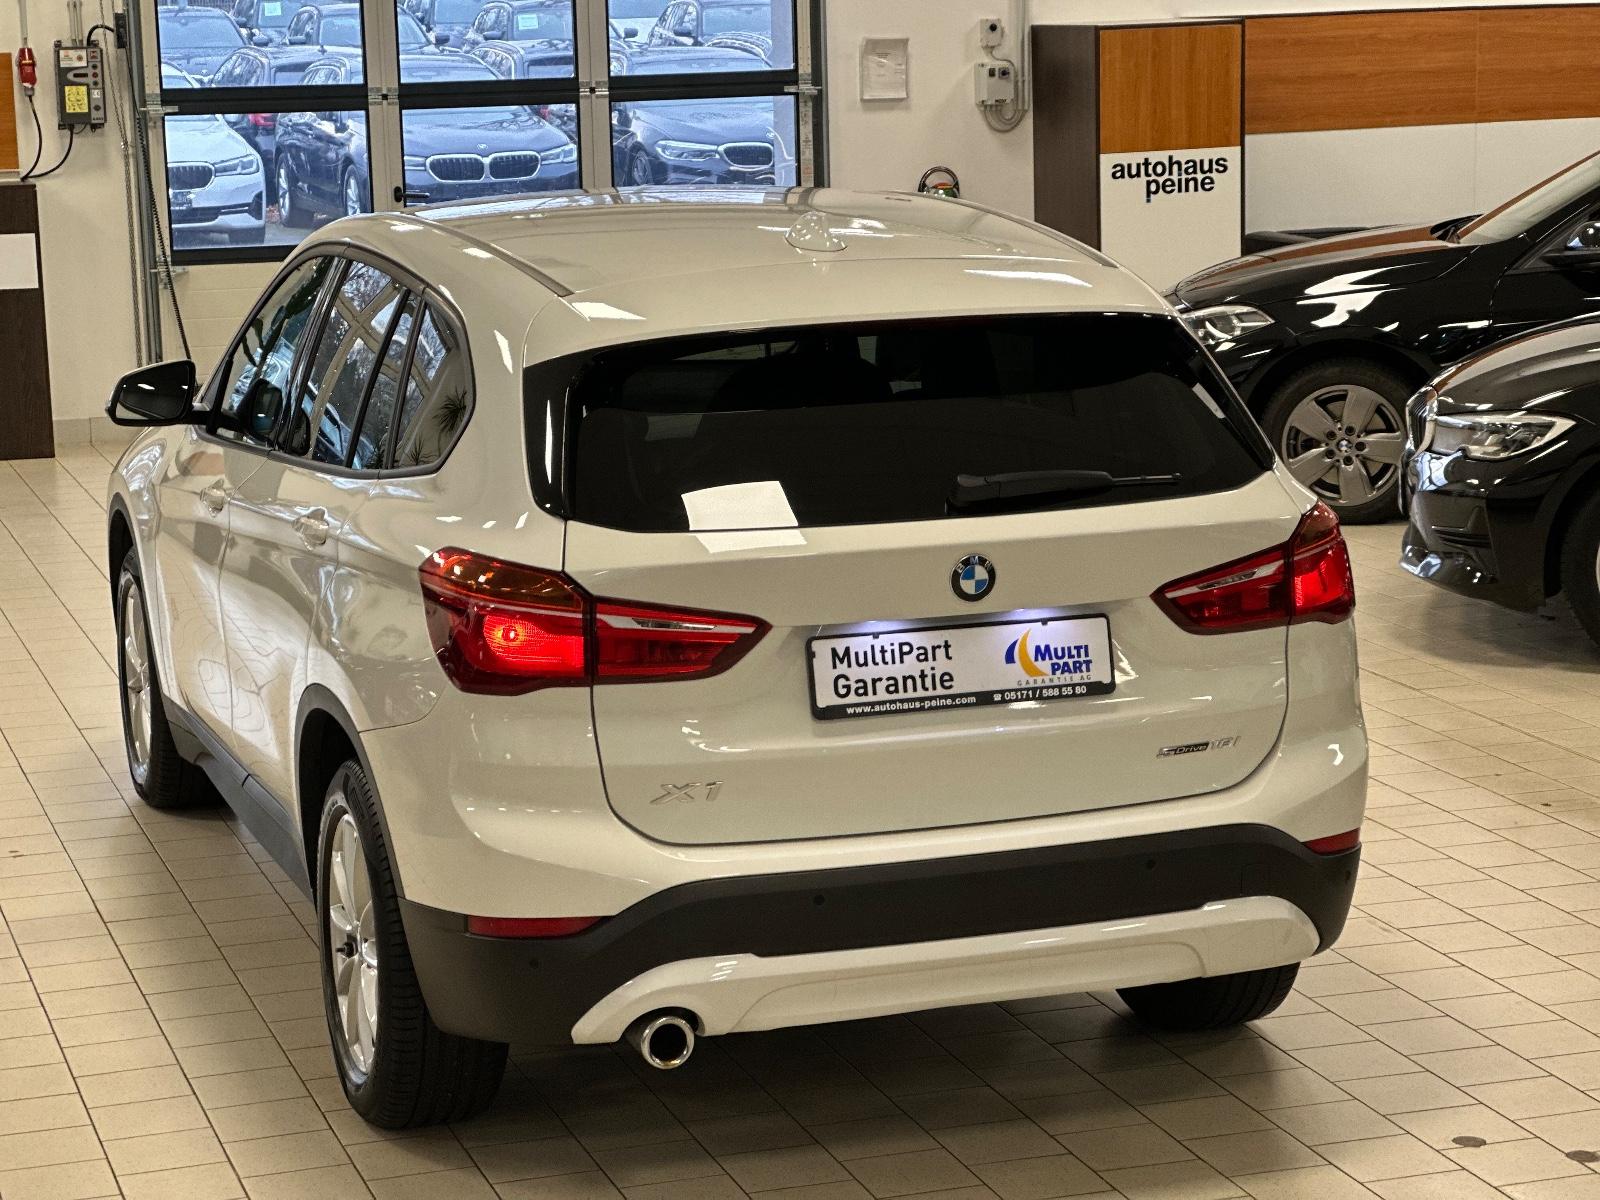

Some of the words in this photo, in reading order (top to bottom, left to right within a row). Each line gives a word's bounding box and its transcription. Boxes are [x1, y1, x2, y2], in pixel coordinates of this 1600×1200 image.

[1111, 154, 1228, 179] autohaus
[1146, 175, 1215, 203] peine
[831, 640, 952, 669] MultiPart
[1034, 644, 1090, 662] MULTI
[1051, 660, 1092, 676] PART
[833, 667, 954, 699] Garantie
[1016, 676, 1074, 687] GARANTIE
[1080, 674, 1092, 682] AG
[846, 695, 976, 714] www.autohaus-peine.com
[1004, 690, 1033, 701] 05171
[1061, 686, 1073, 696] 55
[649, 780, 724, 805] X1
